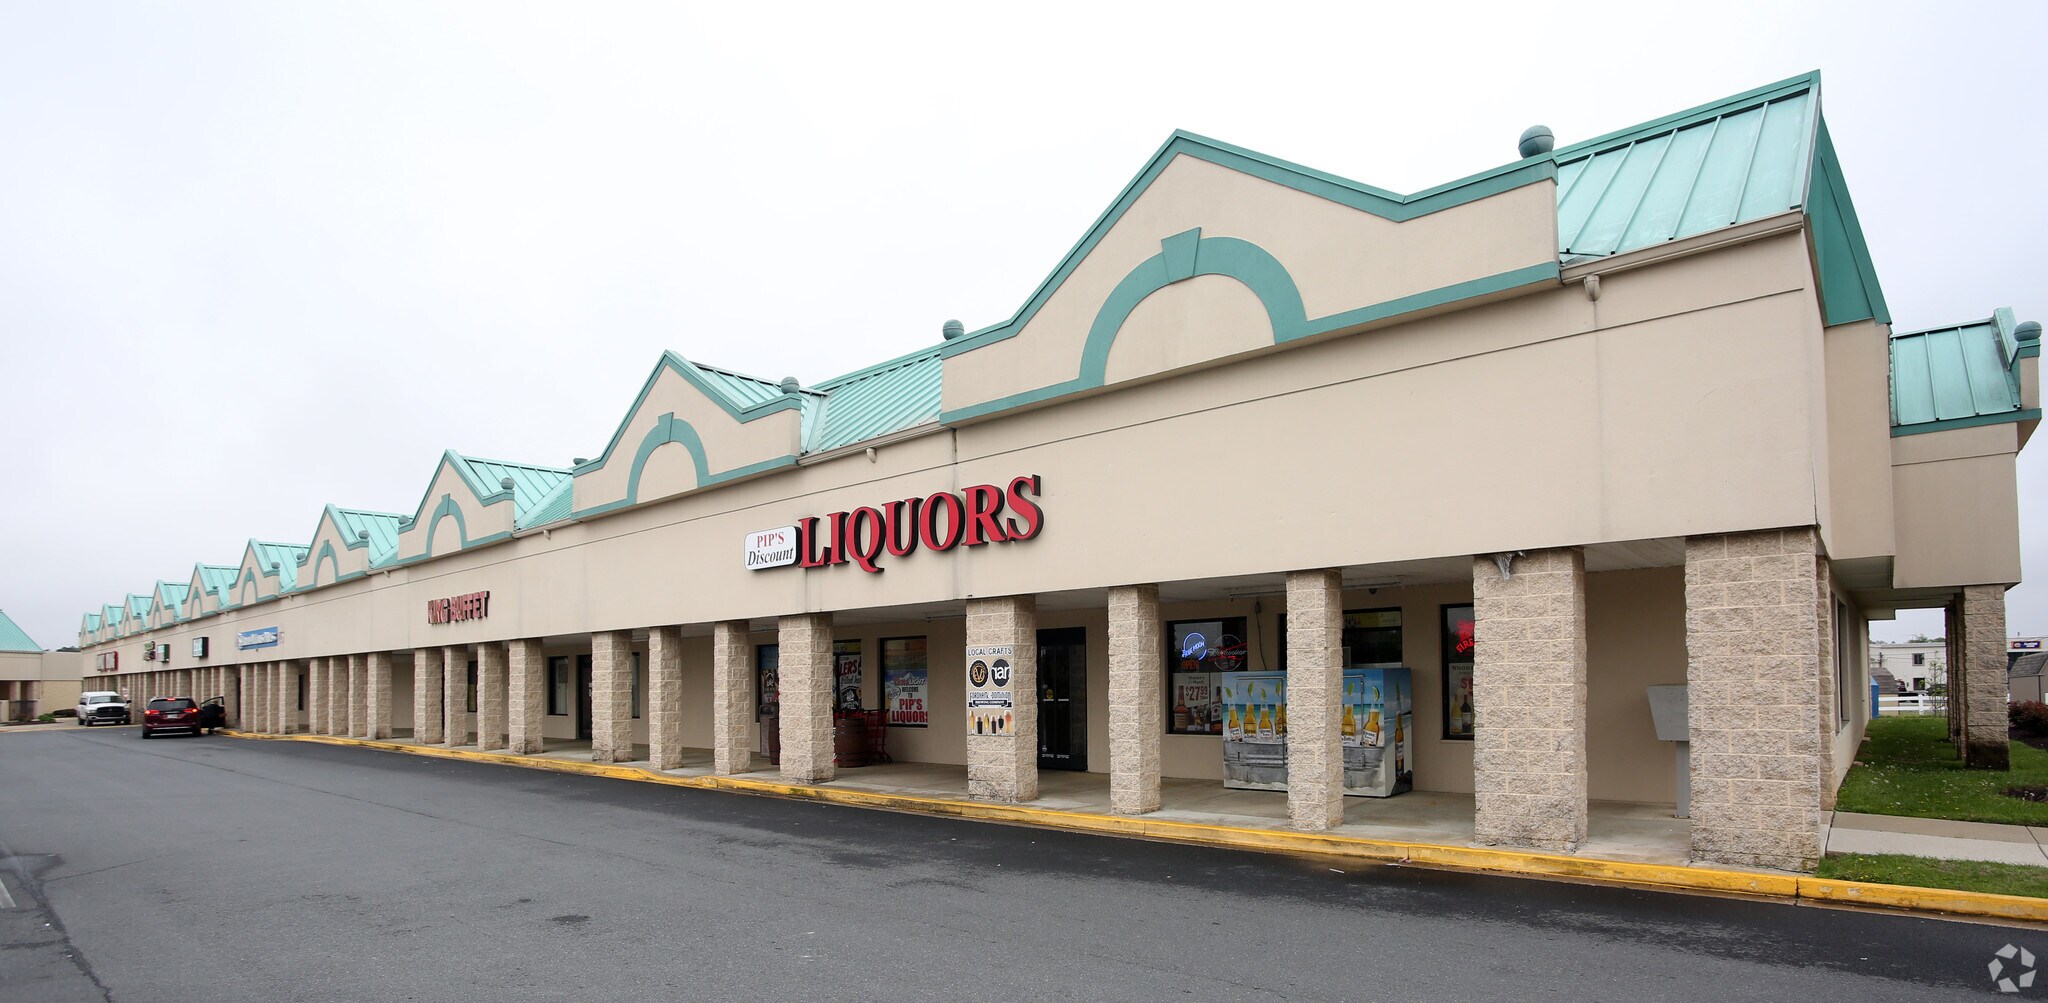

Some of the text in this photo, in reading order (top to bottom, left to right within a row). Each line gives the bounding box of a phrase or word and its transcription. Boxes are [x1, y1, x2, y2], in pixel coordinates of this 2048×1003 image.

[797, 474, 1045, 574] LIQUORS
[755, 530, 785, 550] PIP'S
[746, 547, 795, 567] Discount
[428, 591, 490, 624] KING BUFFET
[968, 647, 1012, 657] LOCAL CRAFTS
[899, 699, 923, 711] PIP'S
